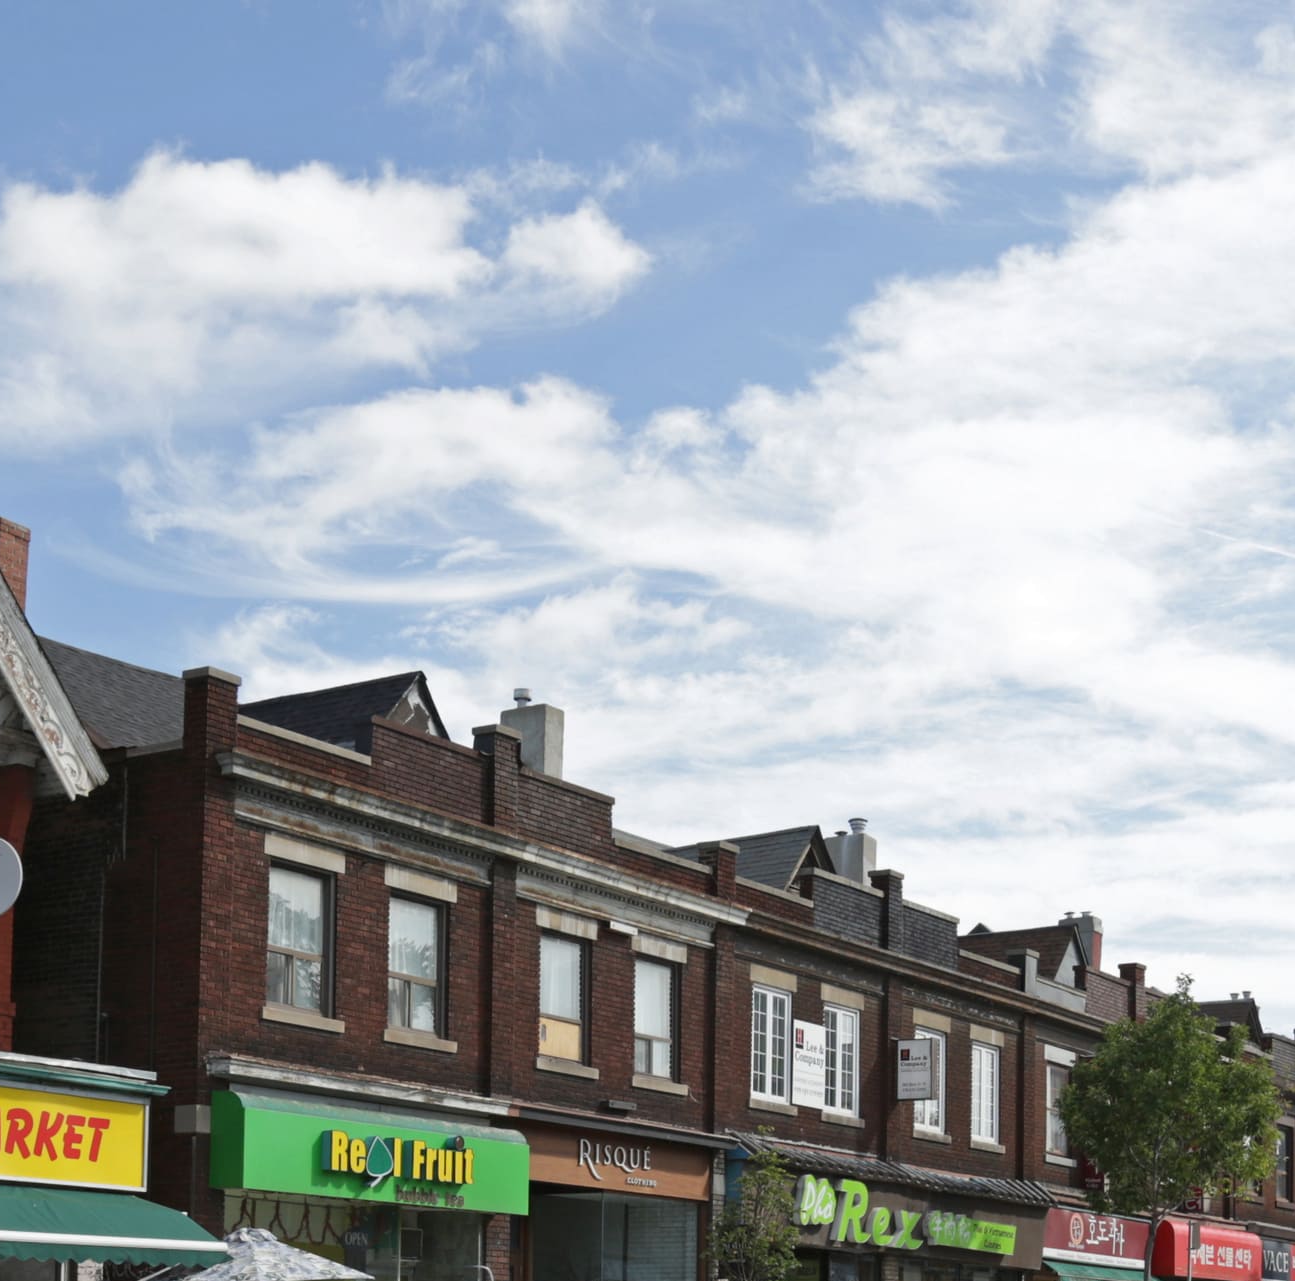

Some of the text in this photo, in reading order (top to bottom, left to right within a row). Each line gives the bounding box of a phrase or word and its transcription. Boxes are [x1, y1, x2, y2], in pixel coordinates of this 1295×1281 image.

[412, 1136, 475, 1185] Fruit
[578, 1138, 652, 1180] RISQUÉ
[837, 1178, 924, 1250] Rex
[1263, 1251, 1289, 1273] VACE
